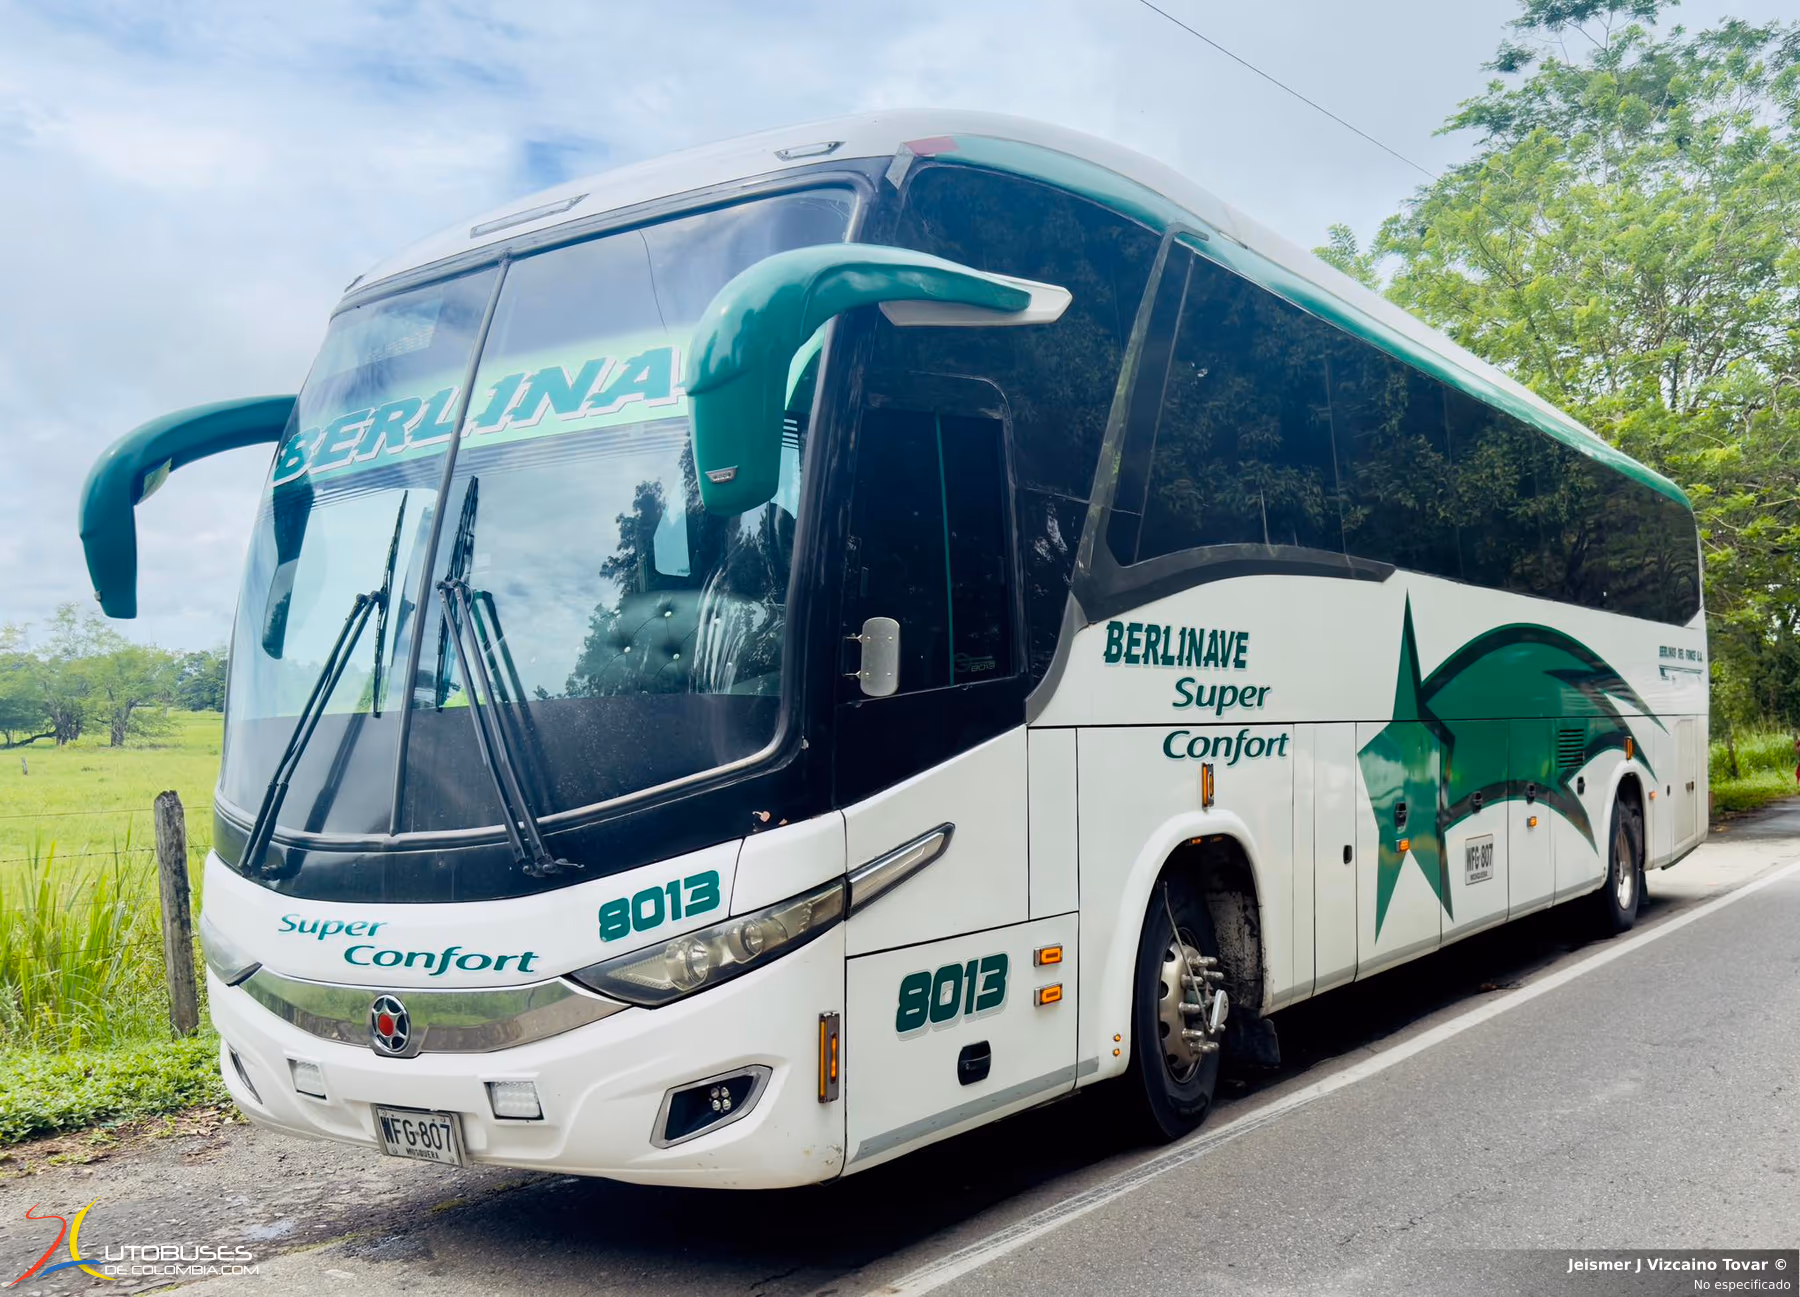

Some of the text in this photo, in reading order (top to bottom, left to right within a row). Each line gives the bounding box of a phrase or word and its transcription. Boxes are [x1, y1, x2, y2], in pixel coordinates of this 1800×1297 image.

[1103, 621, 1249, 669] BERLINAVE
[1172, 677, 1271, 716] Super
[1163, 729, 1290, 766] Confort
[597, 869, 721, 943] 8013
[278, 913, 388, 941] Super
[344, 945, 540, 976] Confort
[895, 952, 1010, 1035] 8013
